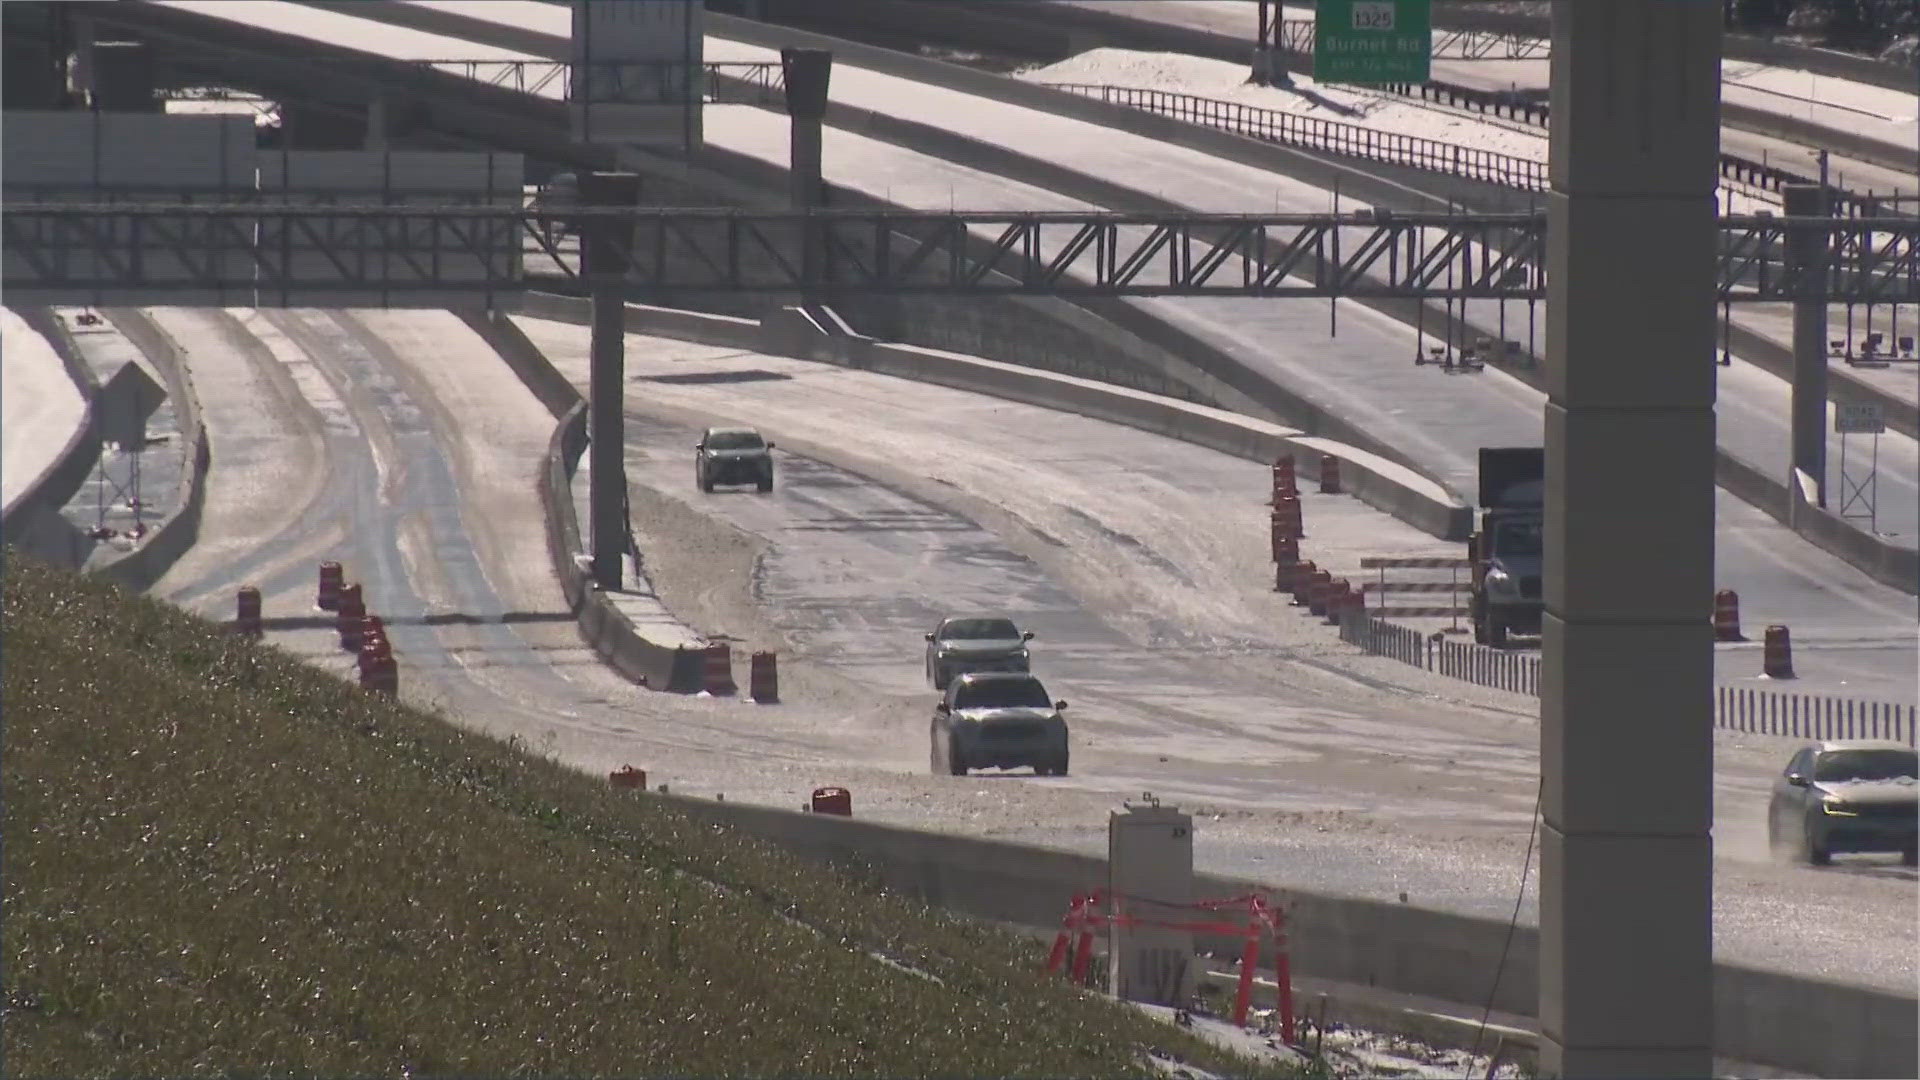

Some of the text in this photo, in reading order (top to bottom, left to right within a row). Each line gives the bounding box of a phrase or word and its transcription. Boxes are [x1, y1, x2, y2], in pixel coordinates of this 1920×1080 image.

[1356, 11, 1391, 26] 1325
[1326, 36, 1420, 53] Burnet Rd
